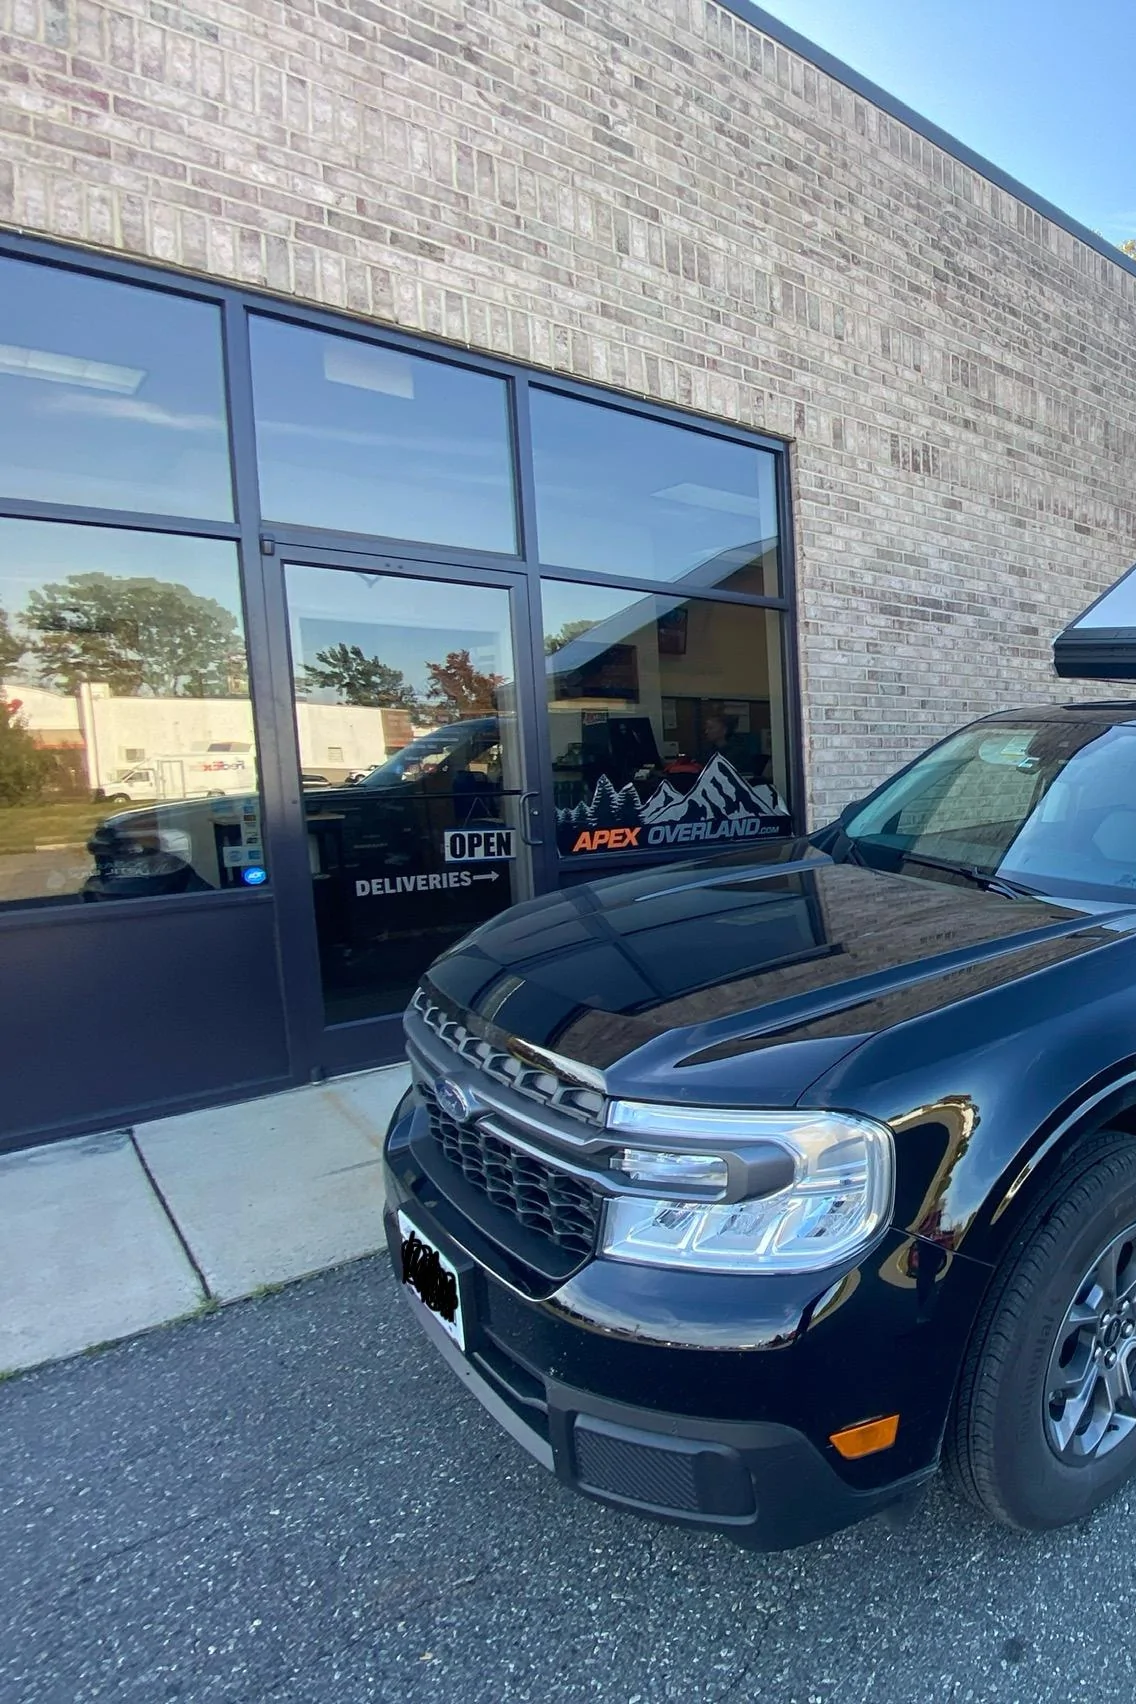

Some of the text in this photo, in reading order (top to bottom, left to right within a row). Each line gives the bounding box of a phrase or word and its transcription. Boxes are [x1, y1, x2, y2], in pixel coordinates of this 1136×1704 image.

[450, 832, 512, 859] OPEN
[572, 826, 641, 852] APEX
[355, 870, 472, 897] DELIVERIES
